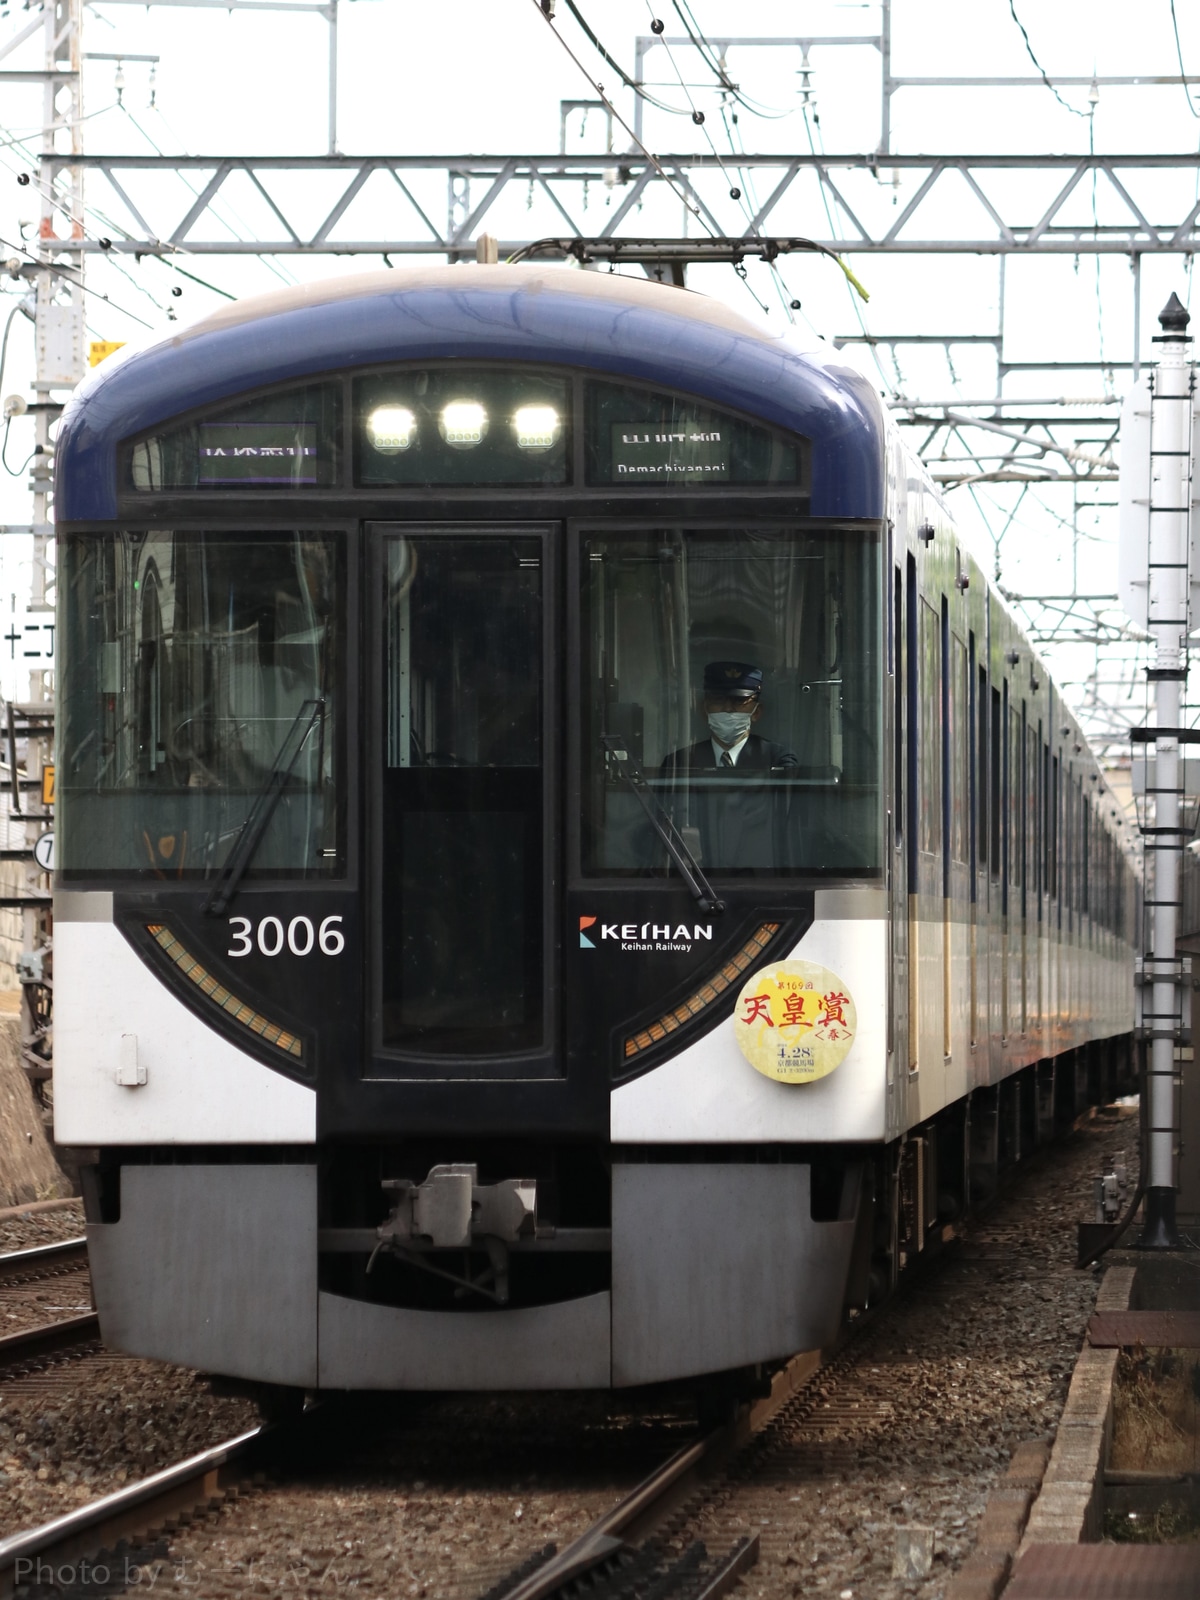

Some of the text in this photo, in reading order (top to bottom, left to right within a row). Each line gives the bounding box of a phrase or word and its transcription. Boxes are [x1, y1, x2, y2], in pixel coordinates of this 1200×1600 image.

[227, 915, 345, 957] 3006
[601, 922, 713, 940] KEIHAN
[621, 942, 692, 952] Keihan Railway
[777, 981, 814, 990] 第169回
[740, 991, 850, 1028] 天皇賞
[777, 1047, 810, 1058] 4.28
